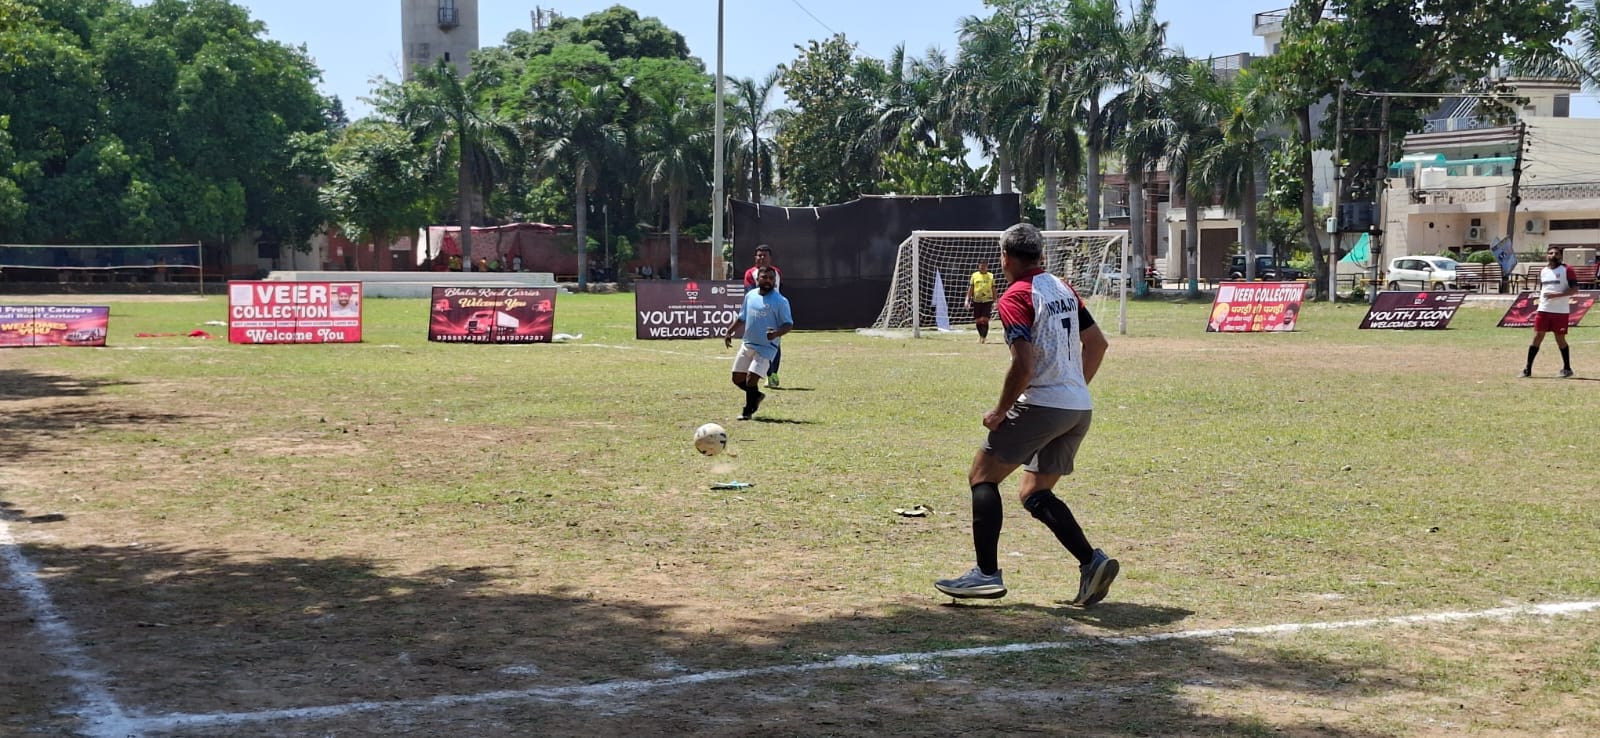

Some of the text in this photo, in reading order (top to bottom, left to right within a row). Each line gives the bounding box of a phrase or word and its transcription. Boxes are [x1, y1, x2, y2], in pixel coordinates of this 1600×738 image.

[256, 285, 328, 304] VEER
[507, 288, 540, 297] Carrier
[1234, 287, 1302, 302] VEER COLLECTION
[5, 306, 45, 314] Freight
[48, 306, 93, 314] Carriers
[458, 297, 527, 311] Welcome You
[232, 305, 328, 319] COLLECTION
[640, 310, 697, 325] YOUTH
[1368, 310, 1454, 321] YOUTH ICON
[1, 322, 68, 331] WELCOMES
[1370, 320, 1440, 328] WELCOMES YOU
[245, 328, 345, 343] Welcome You
[649, 327, 709, 337] WELCOMES
[1061, 317, 1071, 361] 7
